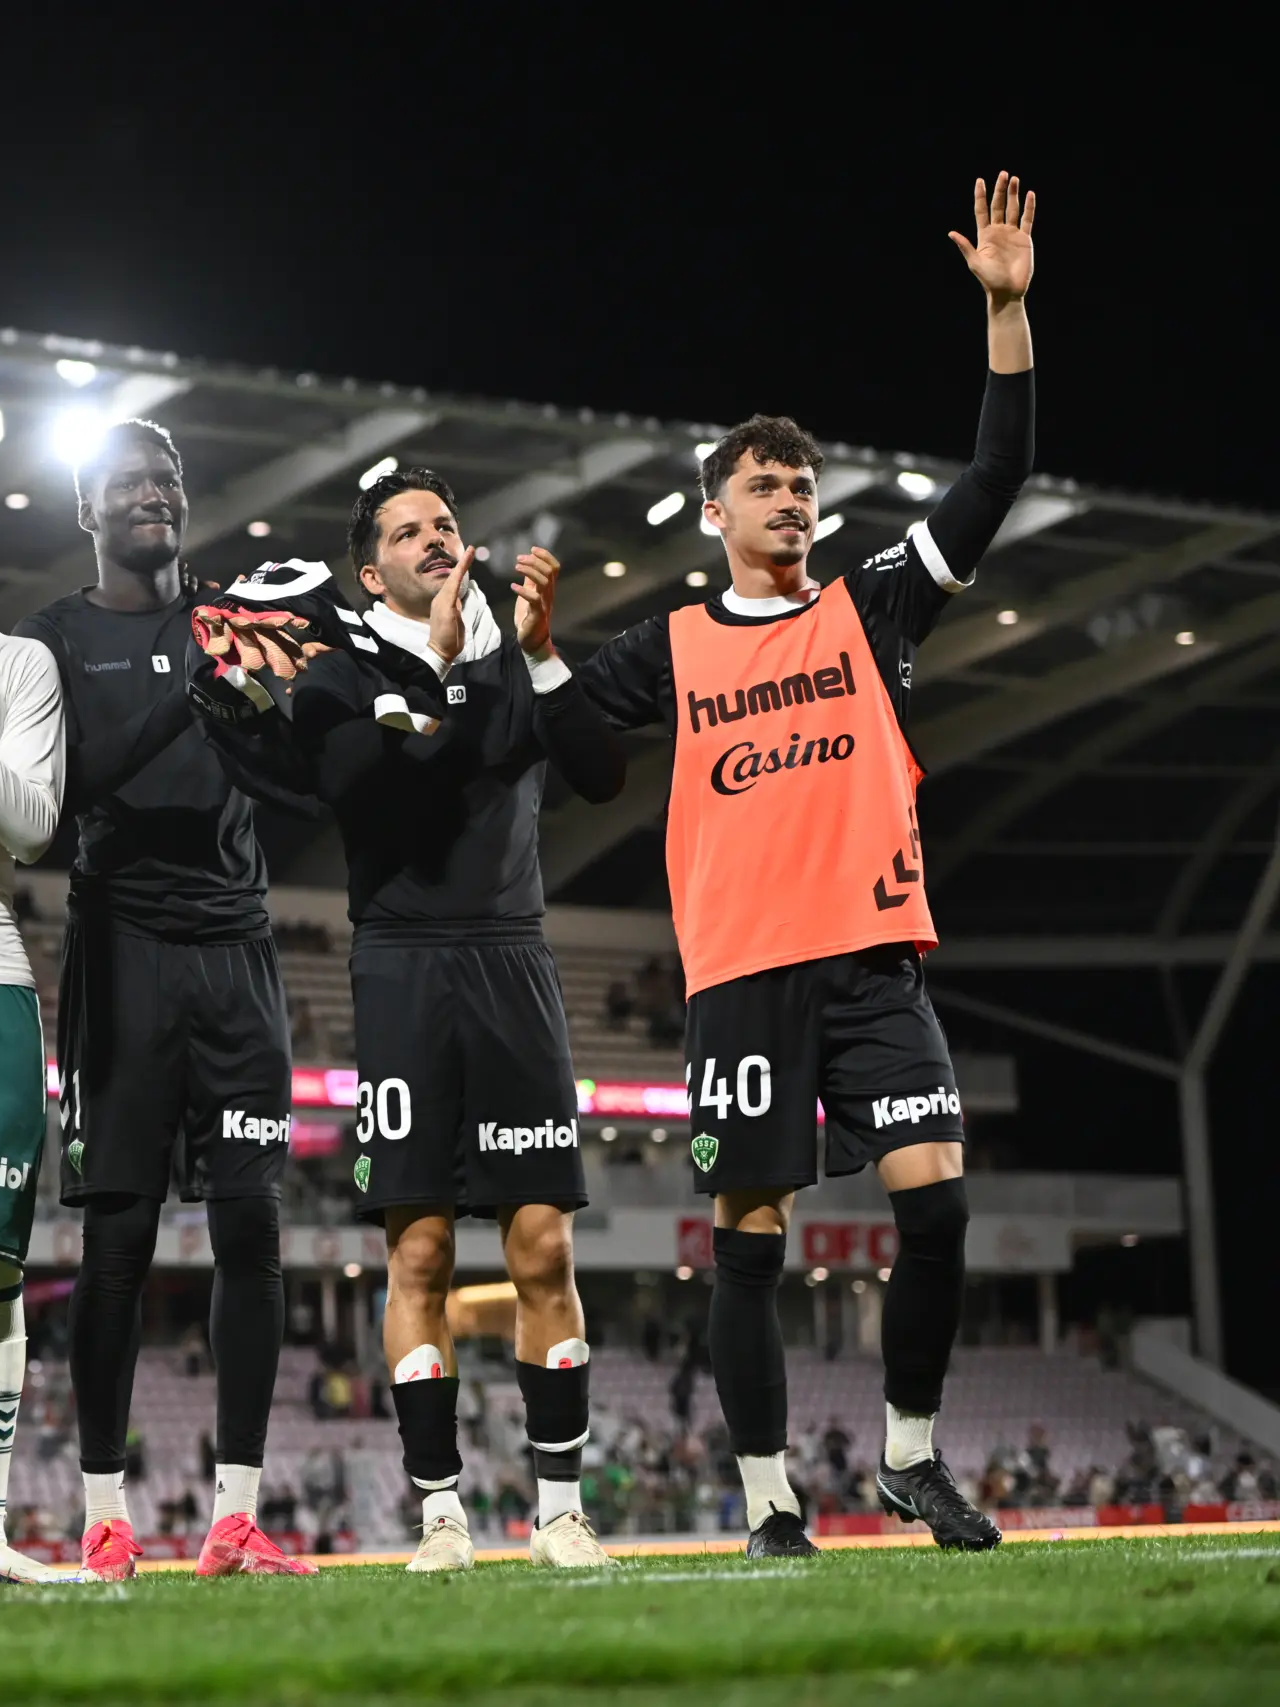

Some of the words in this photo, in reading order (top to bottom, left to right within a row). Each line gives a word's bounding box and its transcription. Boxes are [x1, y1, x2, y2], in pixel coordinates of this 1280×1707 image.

[84, 658, 132, 672] hummel
[449, 688, 465, 701] 30
[687, 651, 857, 734] hummel
[710, 732, 856, 796] Casino
[698, 1054, 772, 1120] 40
[222, 1110, 291, 1146] Kapri
[356, 1077, 412, 1144] 30
[871, 1086, 961, 1130] Kaprio
[478, 1118, 578, 1156] Kapriol
[693, 1139, 715, 1149] ASSE
